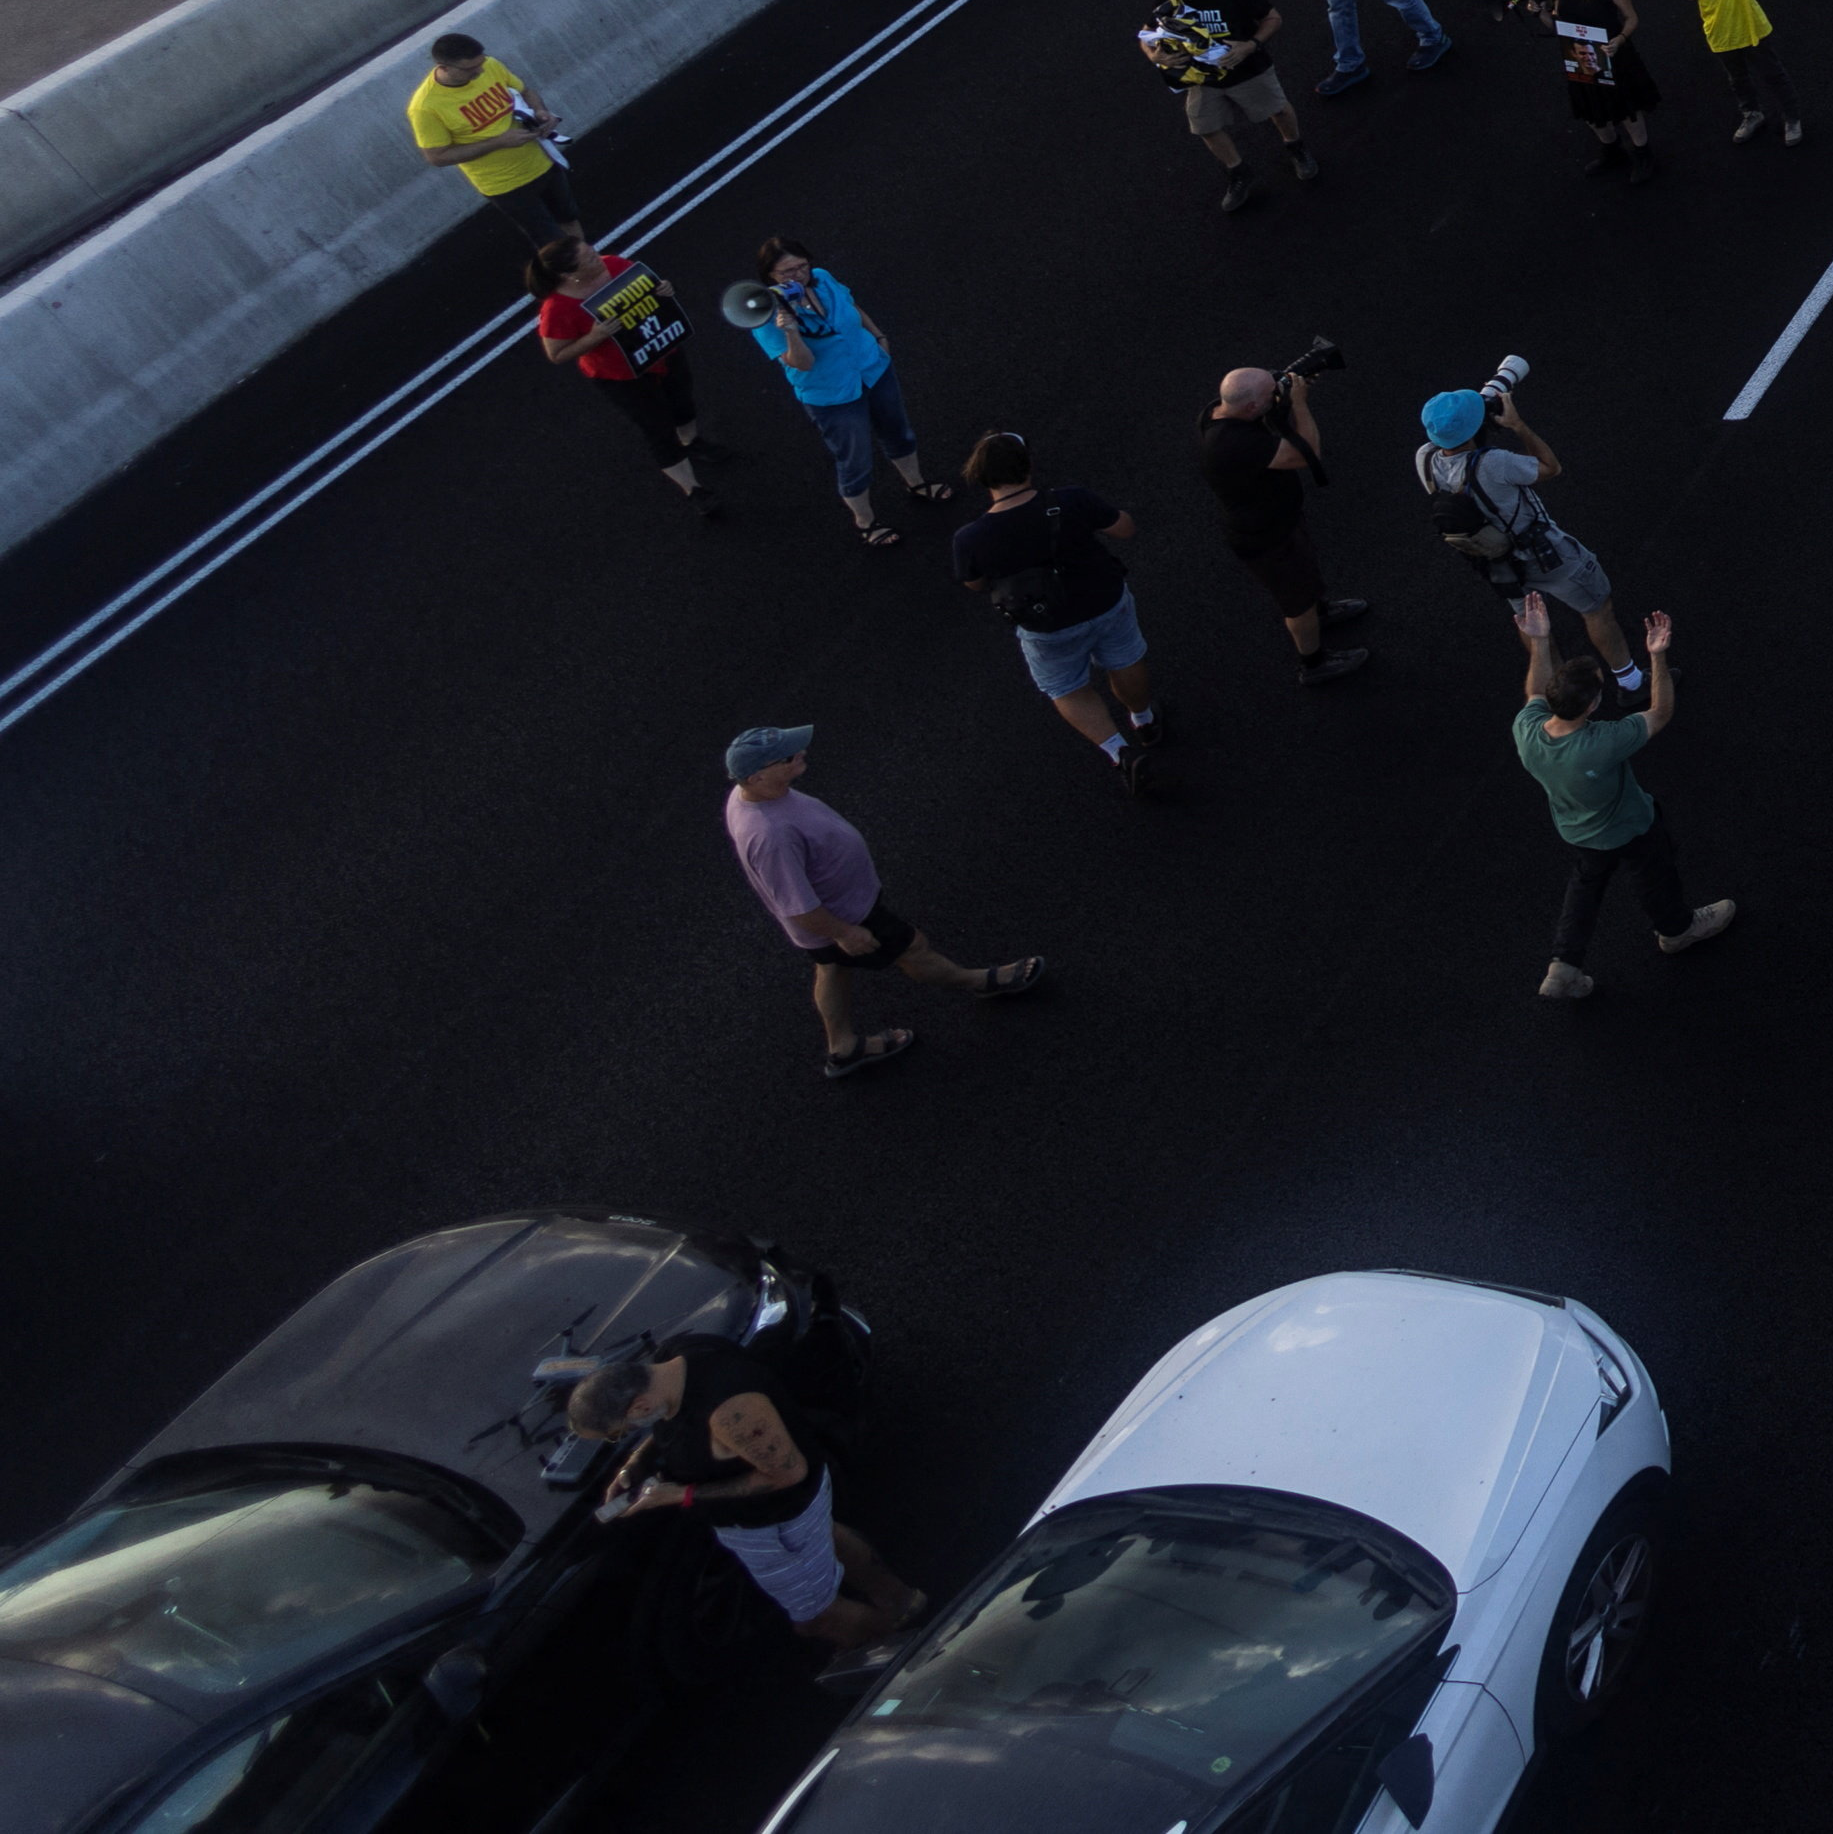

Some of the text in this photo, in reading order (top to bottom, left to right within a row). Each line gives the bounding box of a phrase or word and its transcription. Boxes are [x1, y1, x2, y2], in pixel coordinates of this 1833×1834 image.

[459, 82, 515, 129] NOW
[598, 274, 655, 320] חטופים
[619, 293, 661, 332] מתים
[633, 320, 686, 367] מדברים
[638, 314, 662, 340] לא
